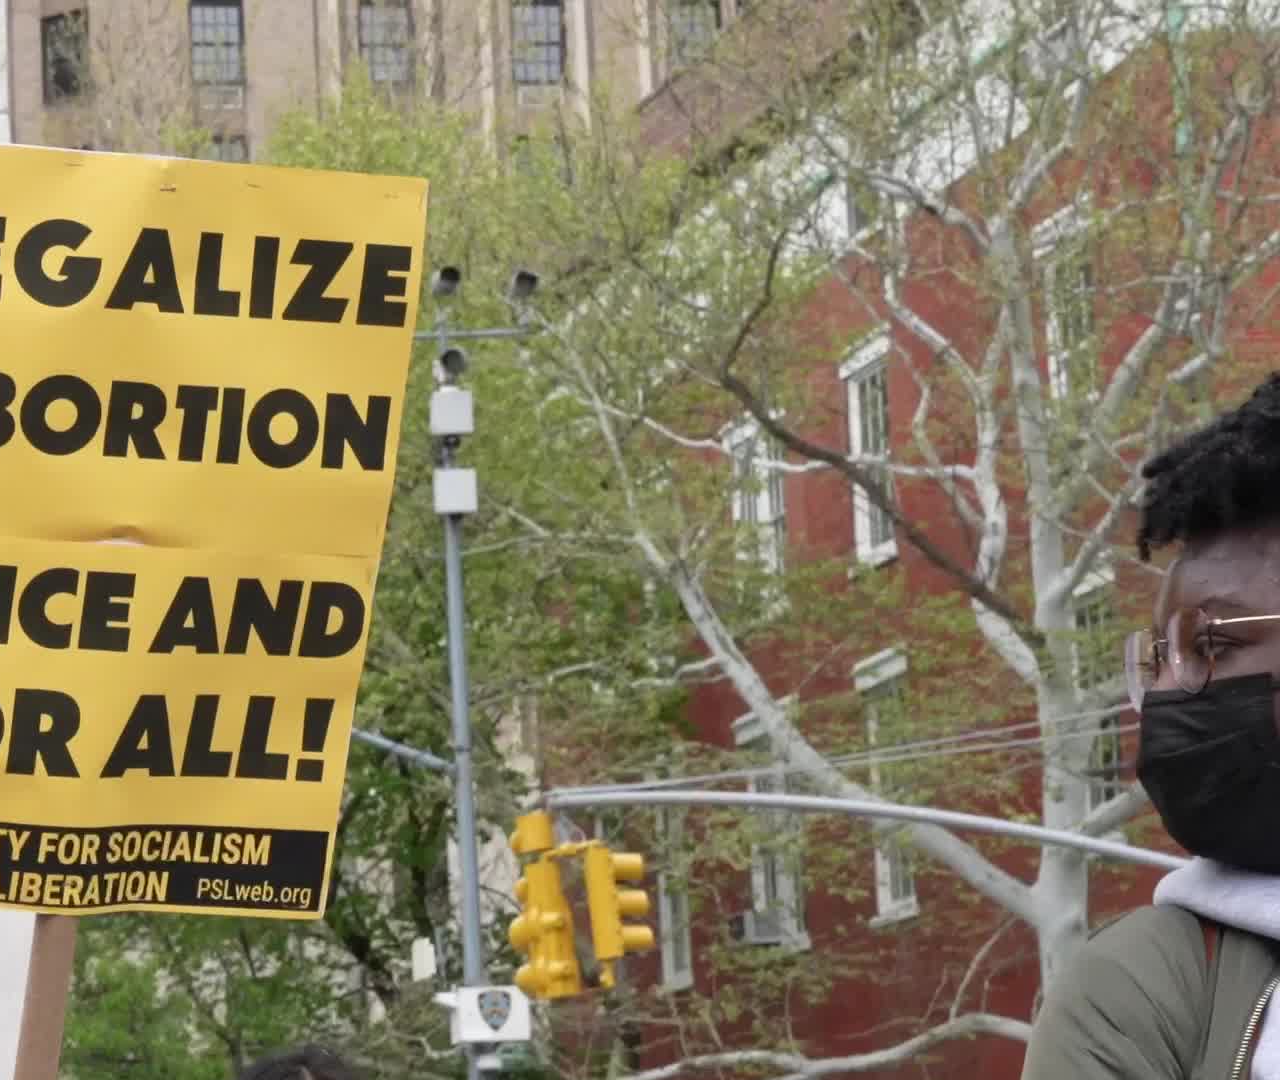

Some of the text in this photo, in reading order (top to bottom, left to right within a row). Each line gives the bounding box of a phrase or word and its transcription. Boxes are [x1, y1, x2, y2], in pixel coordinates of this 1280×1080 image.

[147, 576, 366, 659] AND
[99, 694, 336, 782] ALL!
[37, 832, 101, 865] FOR
[105, 830, 272, 866] SOCIALISM
[195, 878, 312, 909] PSLweb.org
